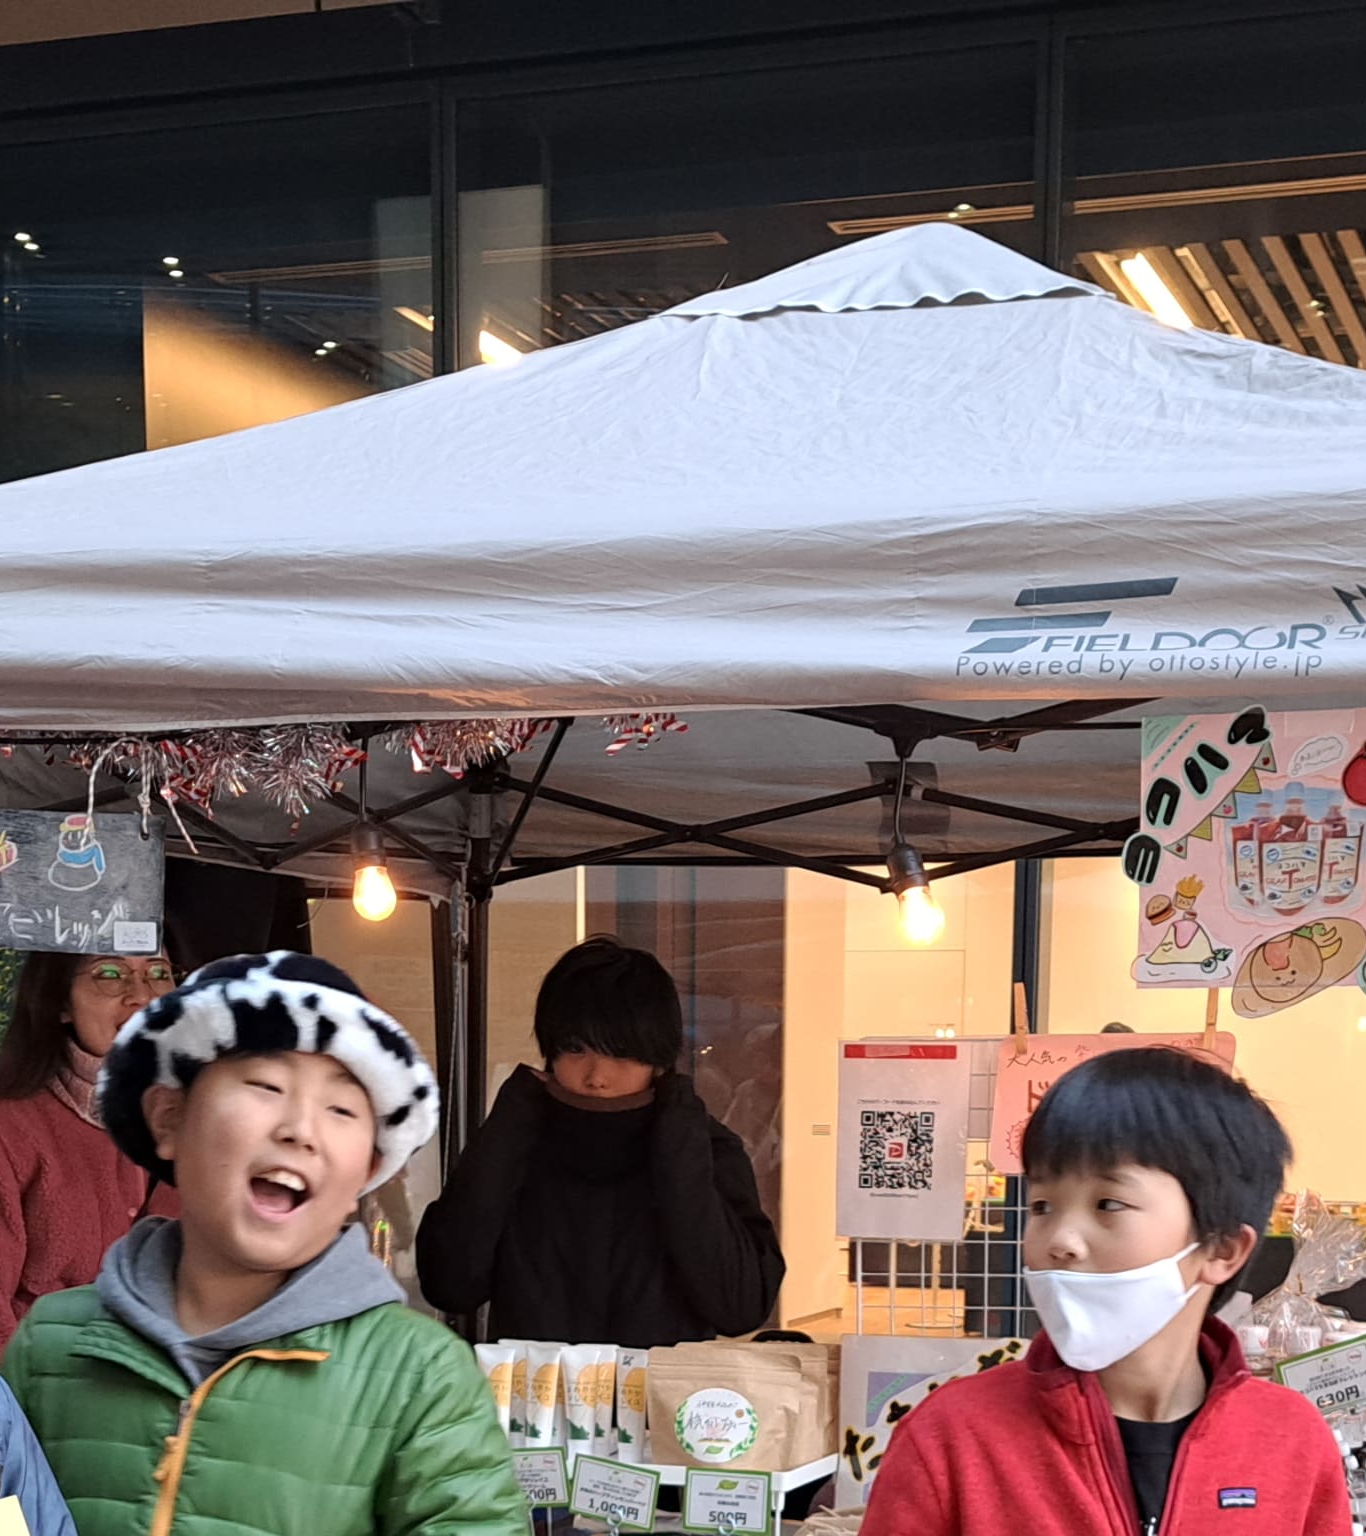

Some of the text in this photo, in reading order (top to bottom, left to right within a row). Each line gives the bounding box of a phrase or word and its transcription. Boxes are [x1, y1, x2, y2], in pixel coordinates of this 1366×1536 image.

[1042, 623, 1327, 652] FIELDOOR
[955, 651, 1323, 680] Powered by ottostyle.jp
[1316, 1385, 1360, 1409] 630円
[587, 1498, 639, 1521] 1,000円
[708, 1511, 747, 1526] 500円
